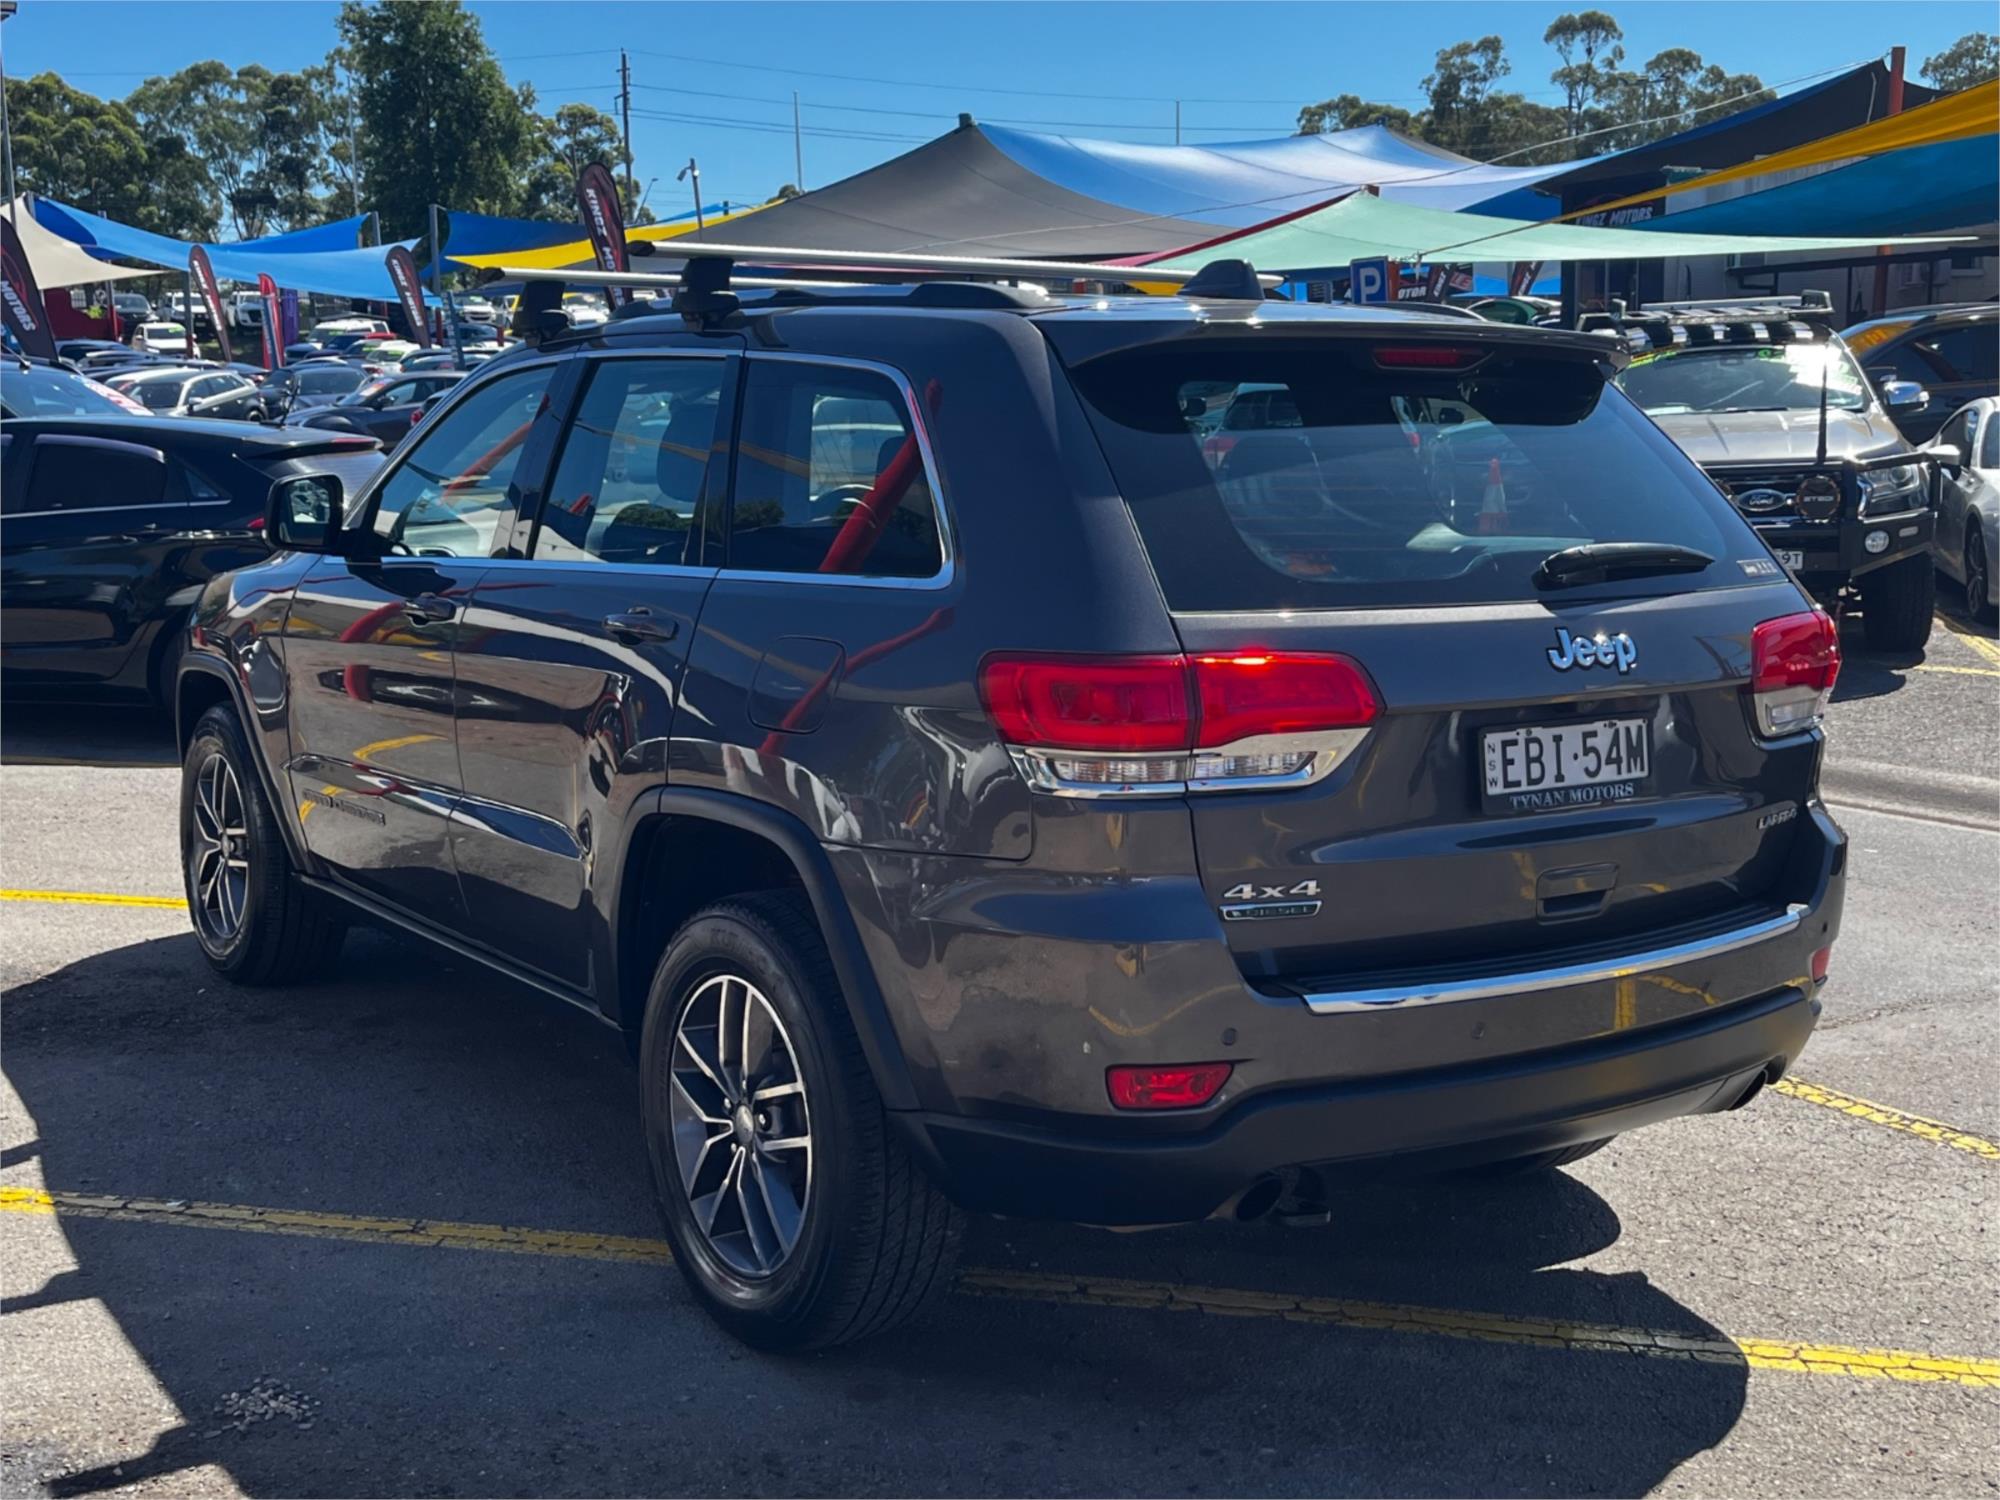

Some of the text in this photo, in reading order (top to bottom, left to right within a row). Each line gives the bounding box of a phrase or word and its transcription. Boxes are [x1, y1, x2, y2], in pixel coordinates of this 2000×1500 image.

[1609, 206, 1654, 225] MOTORS
[586, 188, 626, 307] KINGZ MORS
[1359, 267, 1382, 305] P
[1749, 494, 1775, 506] Ford
[1547, 627, 1638, 675] Jeep
[1510, 782, 1635, 810] TYNAN MOTORS
[1223, 879, 1322, 900] 4x4
